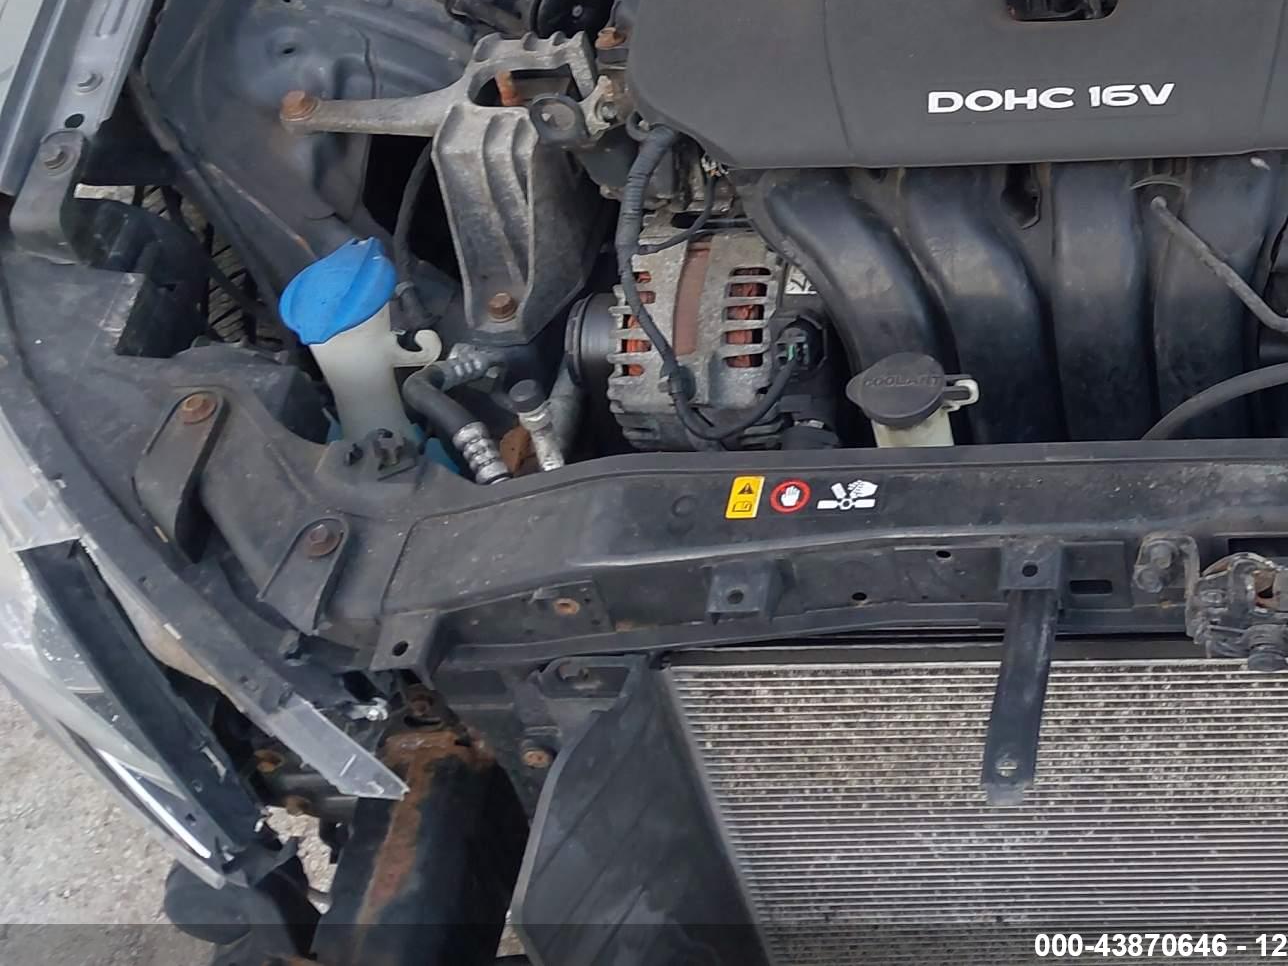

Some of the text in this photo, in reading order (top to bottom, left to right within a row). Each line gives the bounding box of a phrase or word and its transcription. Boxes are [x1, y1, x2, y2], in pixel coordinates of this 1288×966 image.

[927, 83, 1175, 113] DOHC 16V
[863, 375, 942, 388] COOLANT
